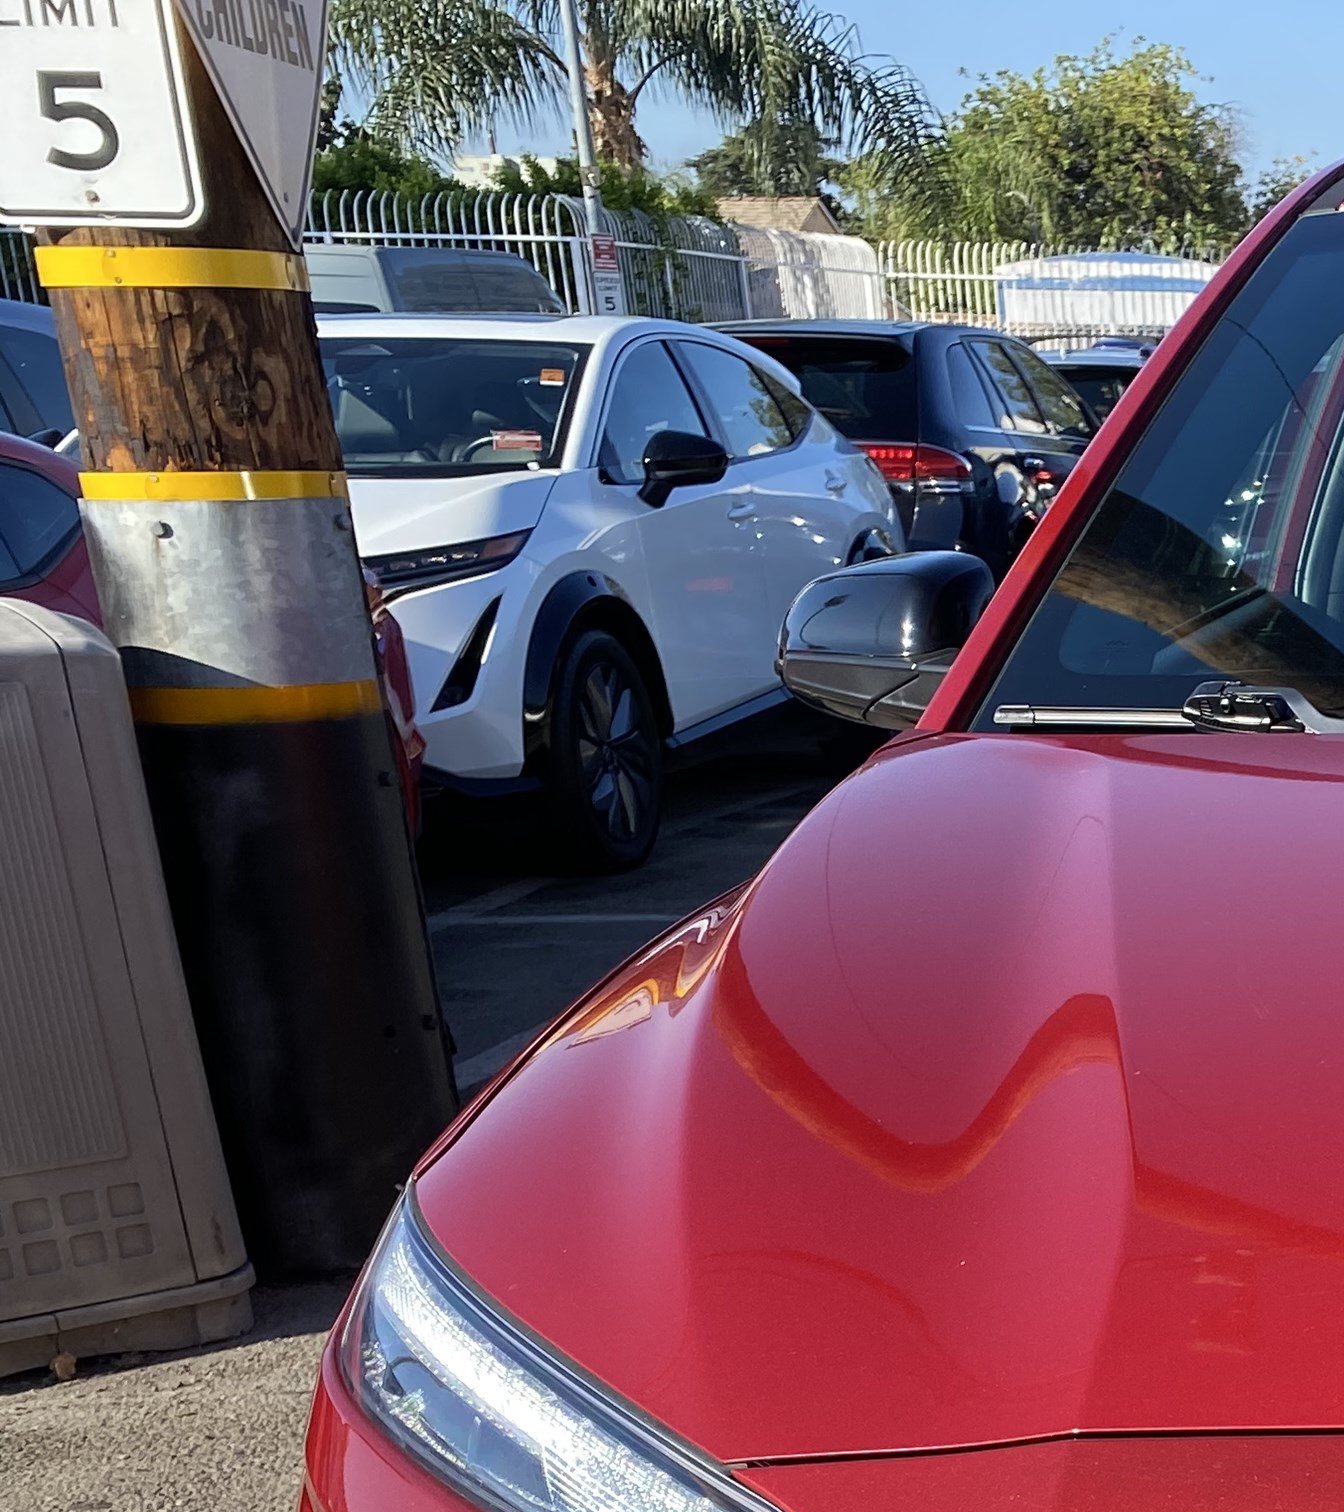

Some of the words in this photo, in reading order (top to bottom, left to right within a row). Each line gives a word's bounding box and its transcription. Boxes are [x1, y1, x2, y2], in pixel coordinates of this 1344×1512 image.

[195, 0, 314, 71] CHILDREN
[36, 69, 120, 172] 5
[604, 296, 616, 311] 5
